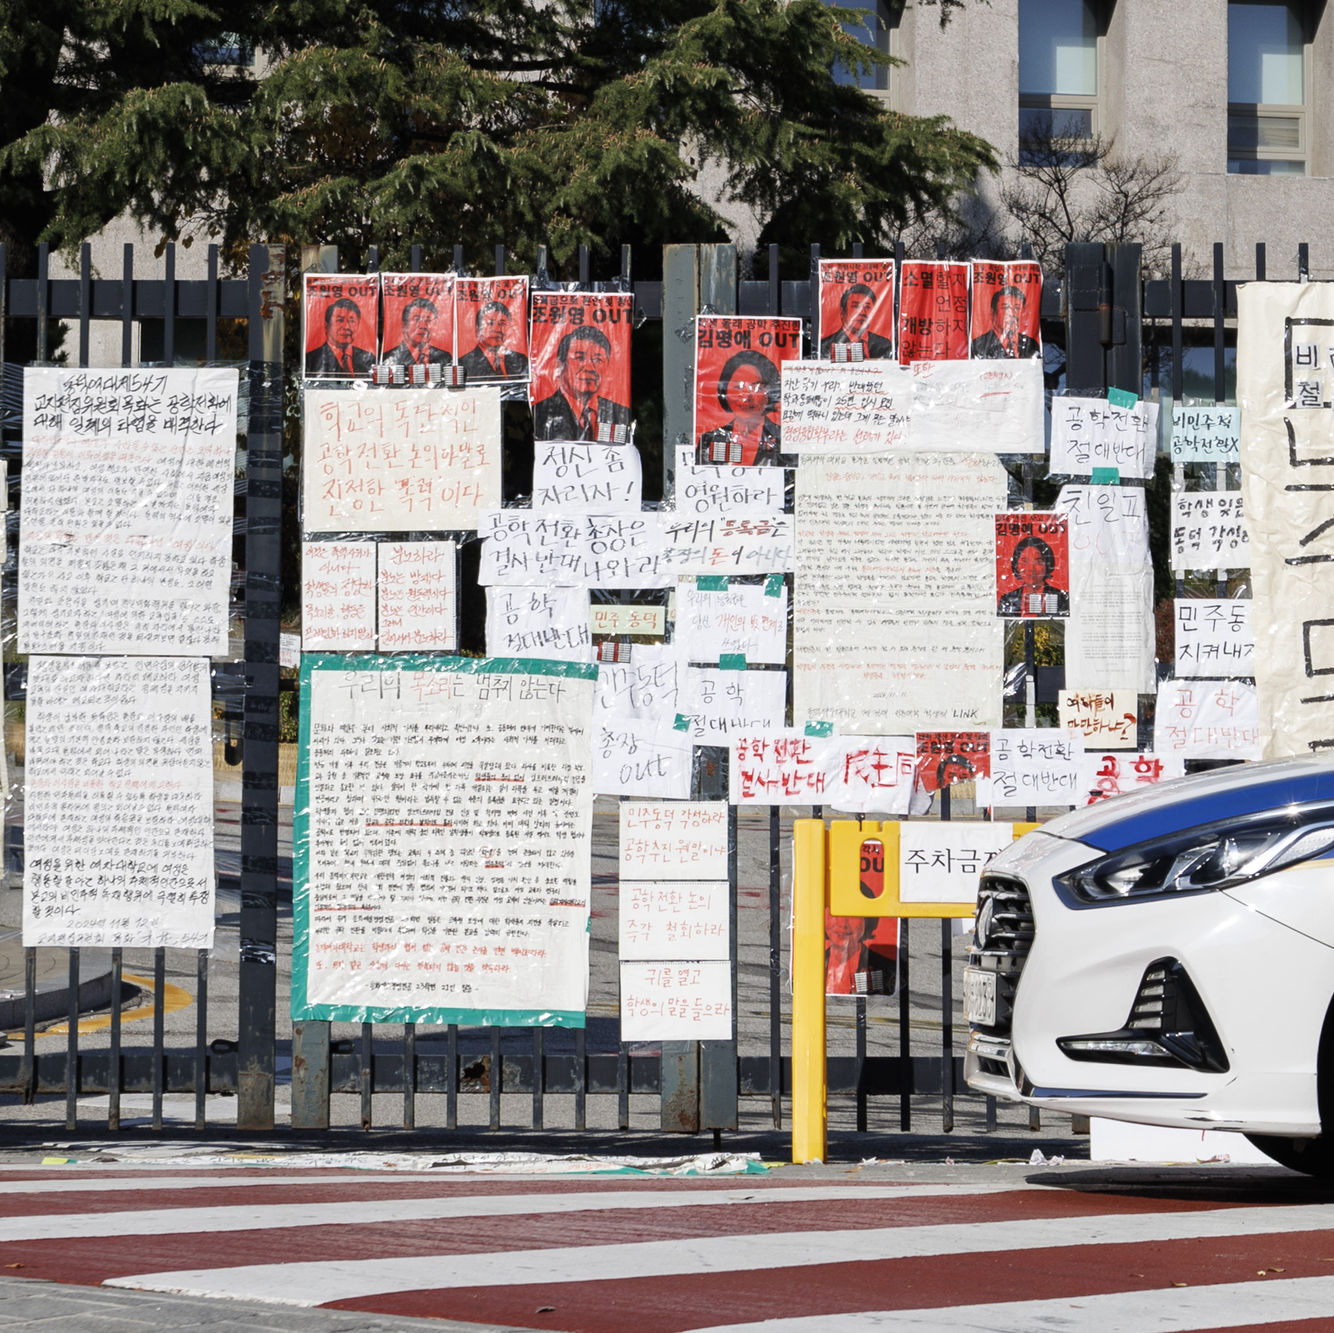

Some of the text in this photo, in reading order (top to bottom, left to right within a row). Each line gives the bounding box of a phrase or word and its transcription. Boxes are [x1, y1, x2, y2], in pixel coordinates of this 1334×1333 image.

[1013, 273, 1041, 284] OUT
[306, 285, 378, 298] 조원영 OUT
[532, 306, 633, 325] 조원영 OUT
[698, 329, 800, 349] 김명애 OUT
[543, 446, 625, 478] 정신 좀
[685, 481, 778, 513] 영원하라
[997, 522, 1067, 538] 김명애 OUT
[628, 808, 725, 831] 민주동덕 각성하라
